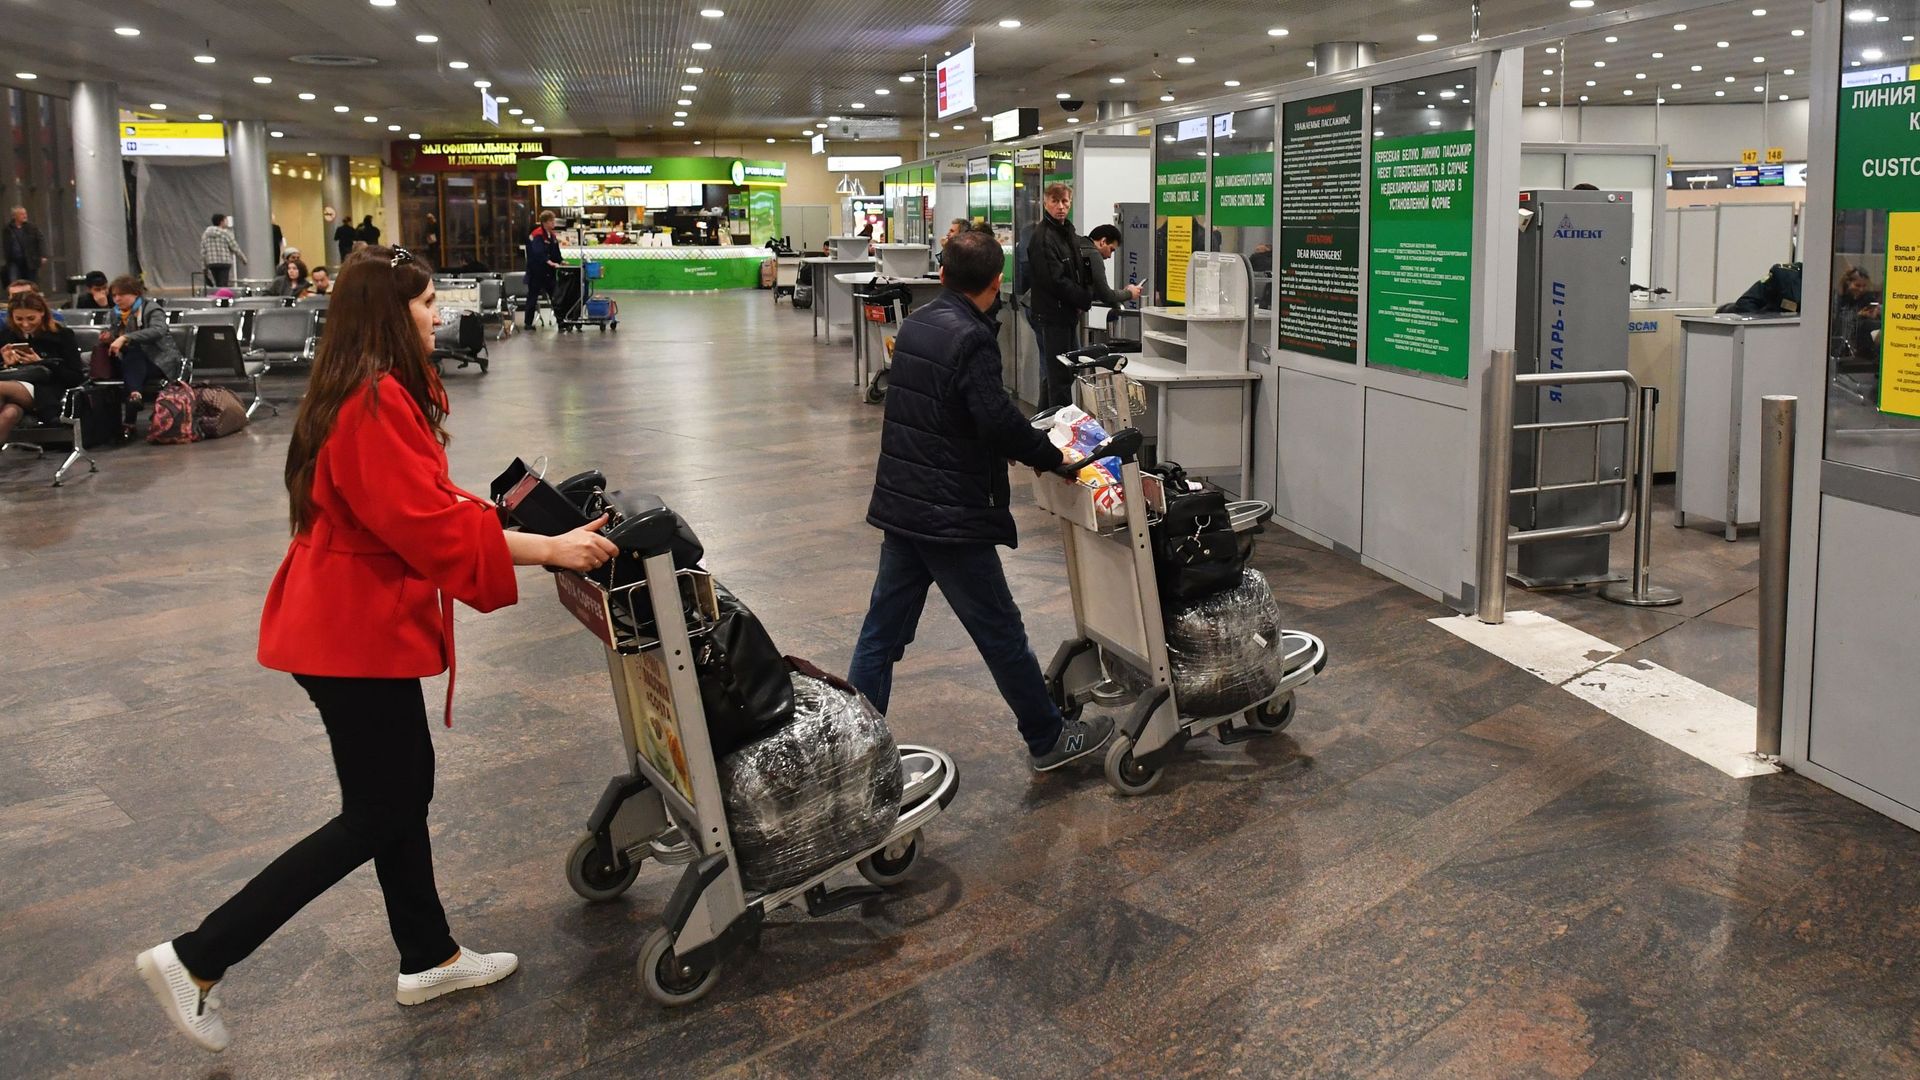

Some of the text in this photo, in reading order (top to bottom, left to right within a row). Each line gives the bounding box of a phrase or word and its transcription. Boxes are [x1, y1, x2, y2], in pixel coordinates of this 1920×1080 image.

[1852, 86, 1916, 109] ЛИНИЯ
[422, 143, 543, 154] ЗАЛ ОФИЦИАЛЬНЫХ ЛИЦ
[1375, 144, 1472, 163] ПЕРЕСЕКАЯ БЕЛУЮ ЛИНИЮ ПАССАЖИР
[448, 154, 516, 165] И ДЕЛЕГАЦИЙ
[1743, 152, 1756, 161] 147
[1768, 151, 1781, 160] 148
[606, 166, 651, 174] КАРТОШКА
[1377, 162, 1468, 178] НЕСЕТ ОТВЕТСТВЕННОСТЬ В СЛУЧАЕ
[1215, 173, 1272, 187] ЗОНА ТАМОЖЕННОГО КОНТРОЛЯ
[1381, 179, 1462, 196] НЕДЕКЛАРИРОВАНИЯ ТОВАРОВ В
[1163, 191, 1176, 202] CUSTOMS
[1177, 191, 1190, 202] CONTROL
[1221, 194, 1265, 207] CUSTOMS CONTROL ZONE
[1389, 195, 1450, 210] УСТАНОВЛЕННОЙ ФОРМЕ
[1553, 230, 1603, 238] АСПЕКТ
[1297, 249, 1342, 260] DEAR PASSENGERS!
[1628, 322, 1658, 331] SCAN
[1065, 734, 1084, 752] N
